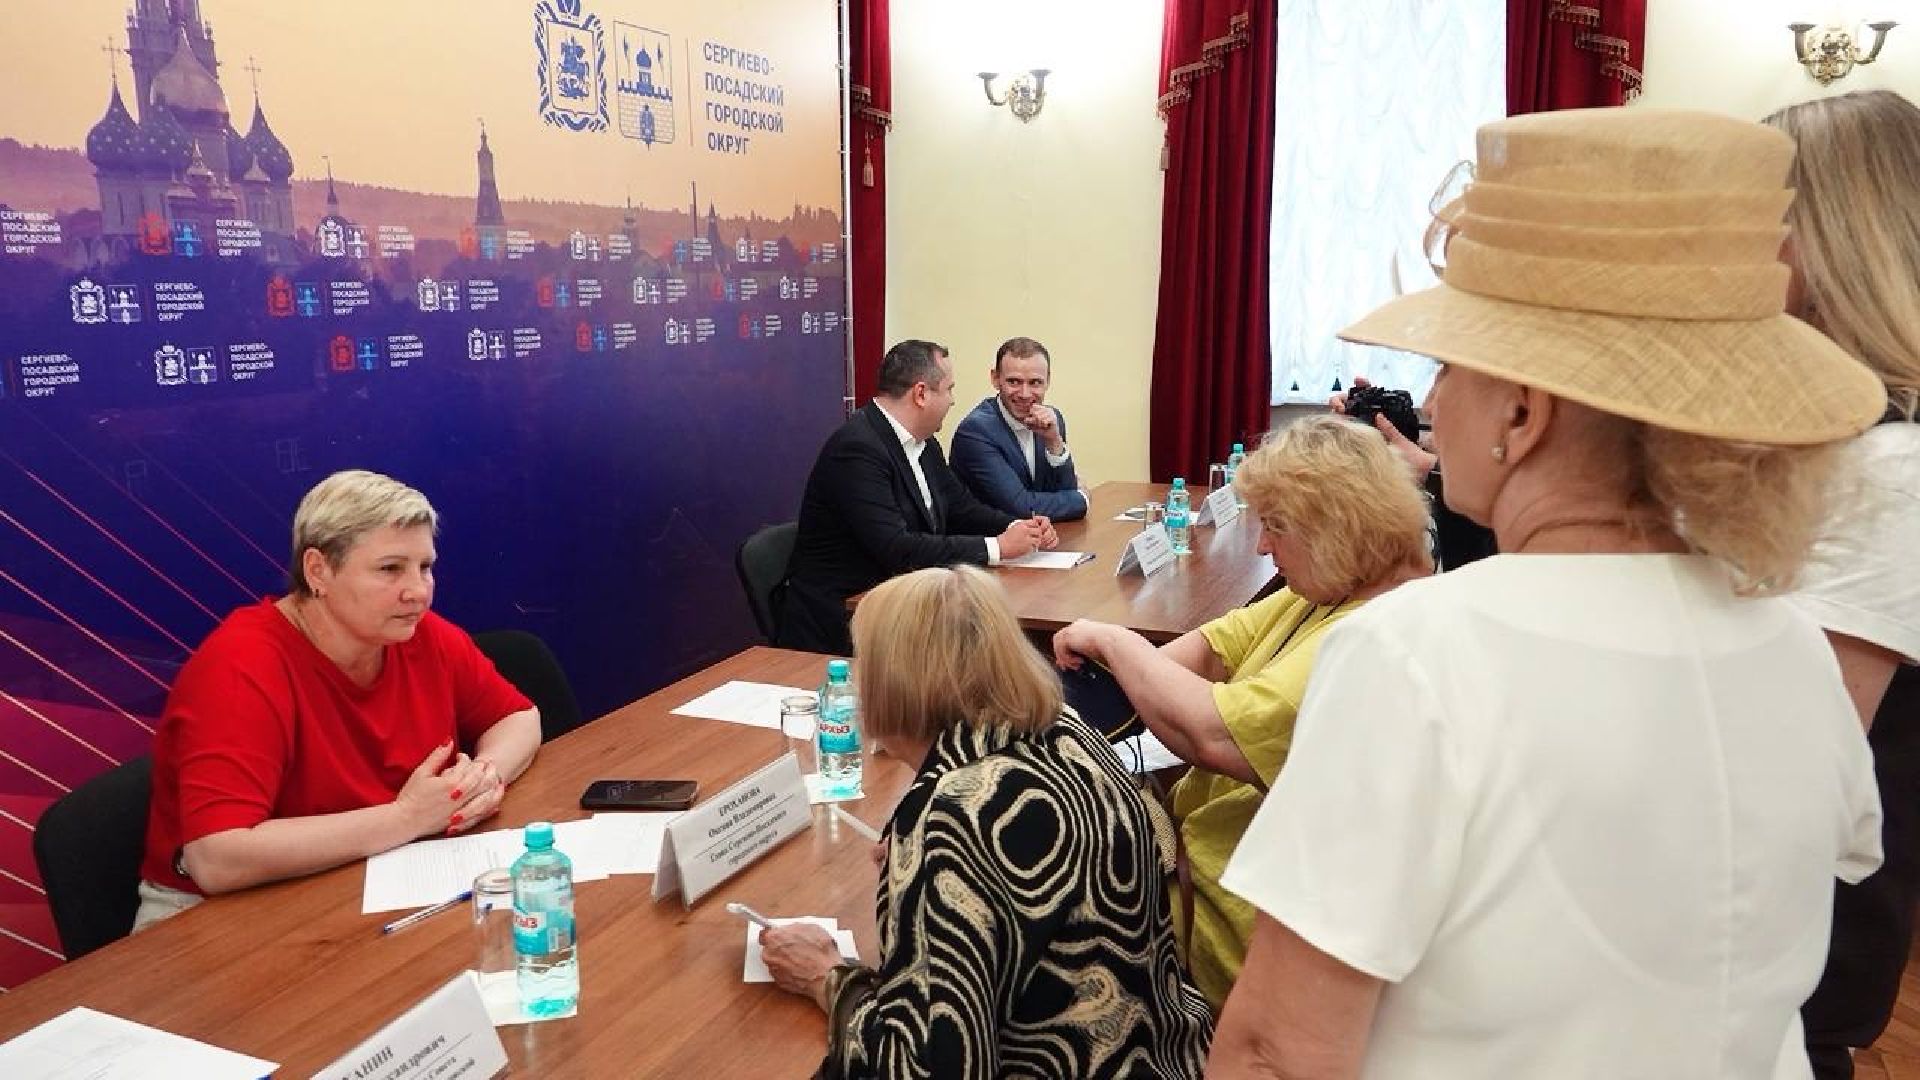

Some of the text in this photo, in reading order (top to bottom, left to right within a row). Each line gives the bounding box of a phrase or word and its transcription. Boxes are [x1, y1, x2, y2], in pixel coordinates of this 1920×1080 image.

[703, 41, 775, 76] СЕРГИЕВО-
[705, 71, 784, 107] ПОСАДСКИЙ
[706, 101, 784, 133] ГОРОДСКОЙ
[707, 132, 750, 155] ОКРУГ
[22, 362, 79, 375] ПОСАДСКИЙ
[24, 373, 80, 386] ГОРОДСКОЙ
